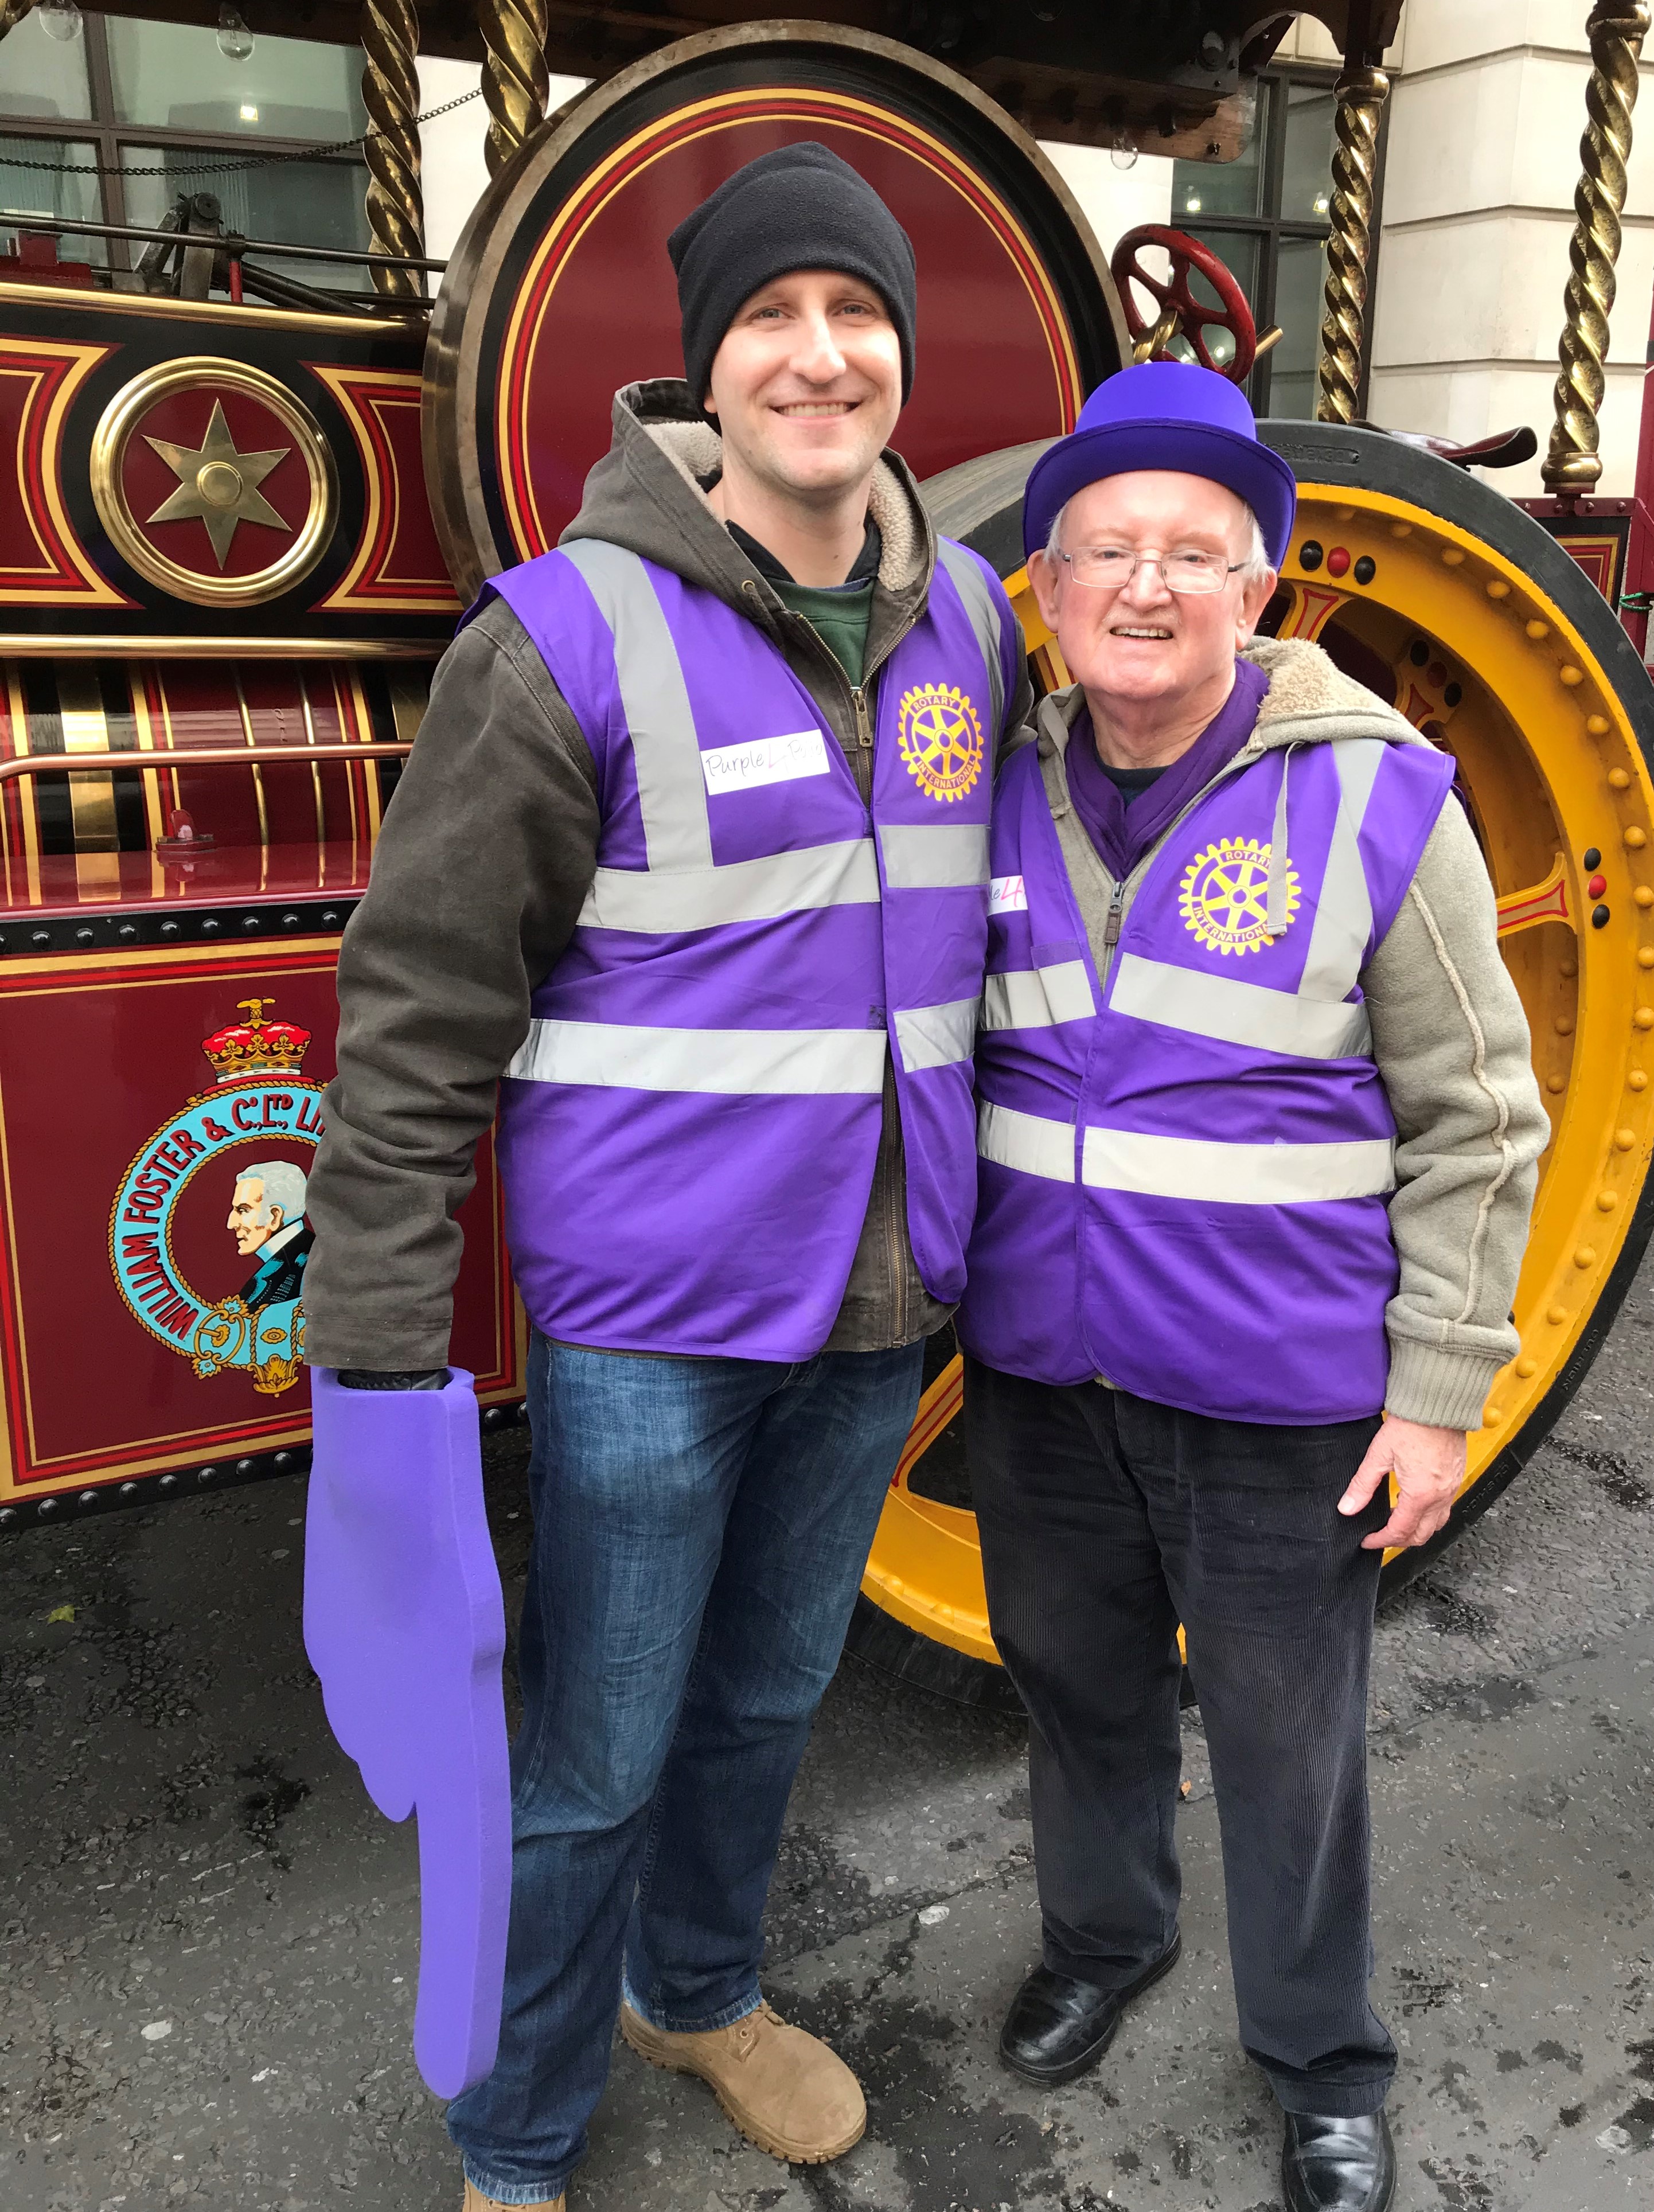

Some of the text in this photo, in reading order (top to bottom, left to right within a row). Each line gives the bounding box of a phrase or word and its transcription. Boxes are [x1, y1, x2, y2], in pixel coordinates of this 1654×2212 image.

[913, 696, 957, 712] ROTARY
[787, 739, 822, 760] Poio
[916, 759, 976, 789] INTERNATIONAL
[1226, 851, 1270, 868] ROTARY
[1193, 906, 1269, 942] INTERNATIONA
[201, 1117, 235, 1141] &
[295, 1096, 326, 1137] LI
[123, 1129, 206, 1224] FOSTER
[122, 1231, 200, 1341] WILLIAM
